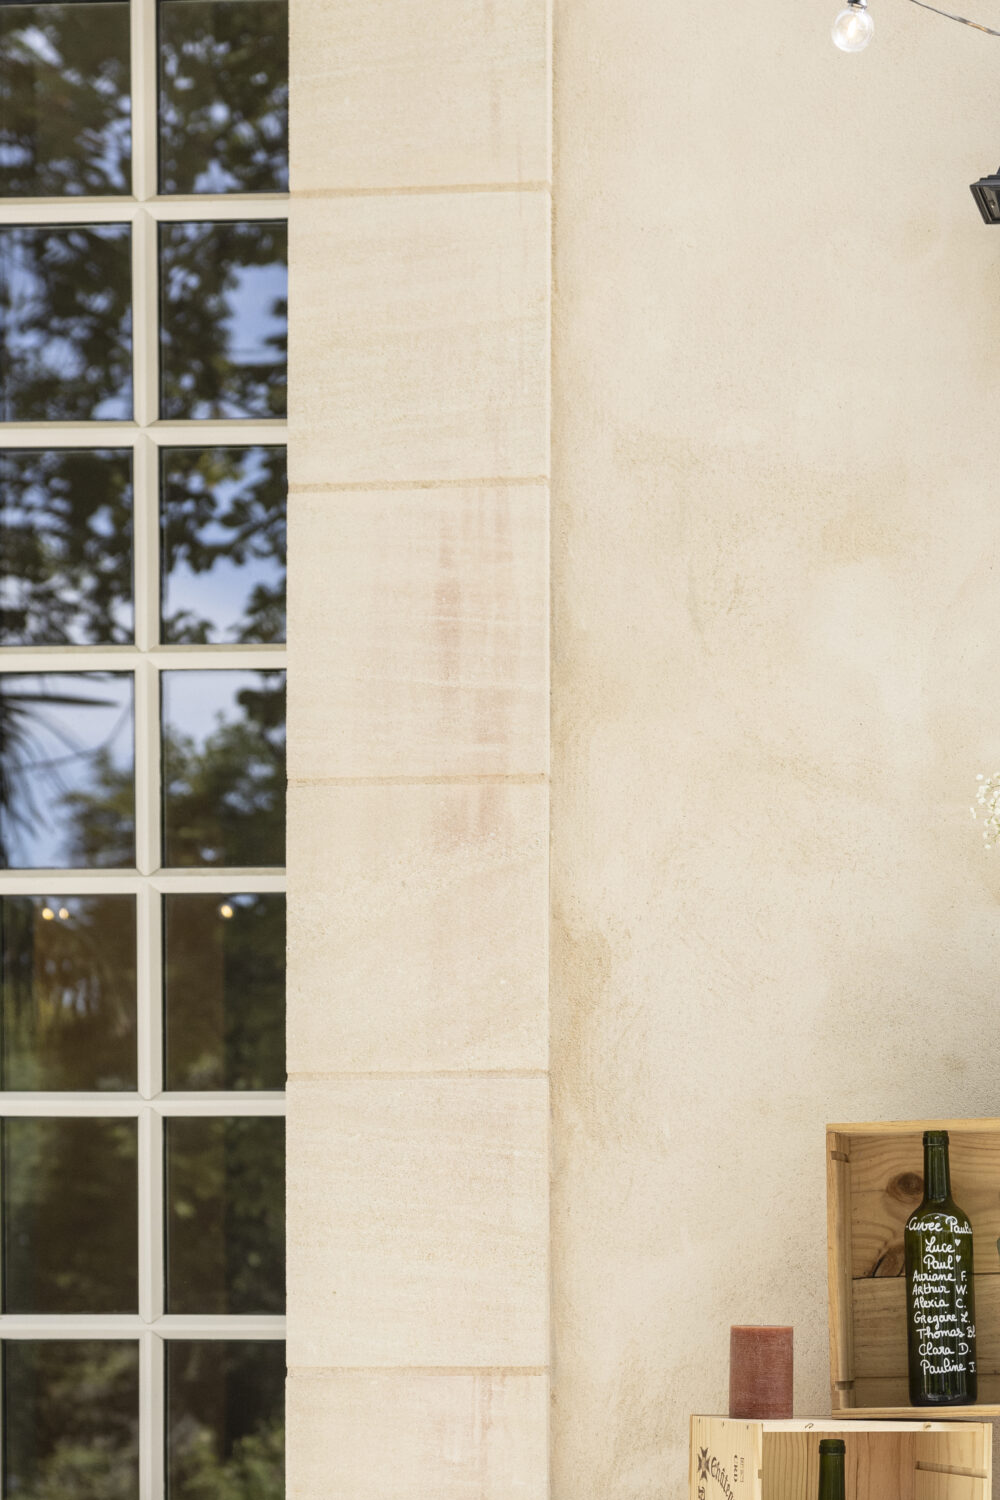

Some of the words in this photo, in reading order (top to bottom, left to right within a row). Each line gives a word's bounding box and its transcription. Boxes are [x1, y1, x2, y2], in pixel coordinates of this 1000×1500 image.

[925, 1236, 955, 1252] Luce
[923, 1254, 953, 1270] Paul
[961, 1271, 967, 1281] F.
[956, 1285, 967, 1295] W.
[914, 1296, 949, 1308] Alexia
[956, 1299, 966, 1308] C.
[961, 1311, 970, 1323] L.
[916, 1326, 965, 1339] Thomas
[919, 1342, 954, 1355] Clara
[958, 1343, 971, 1355] D.
[920, 1358, 966, 1375] Pauline
